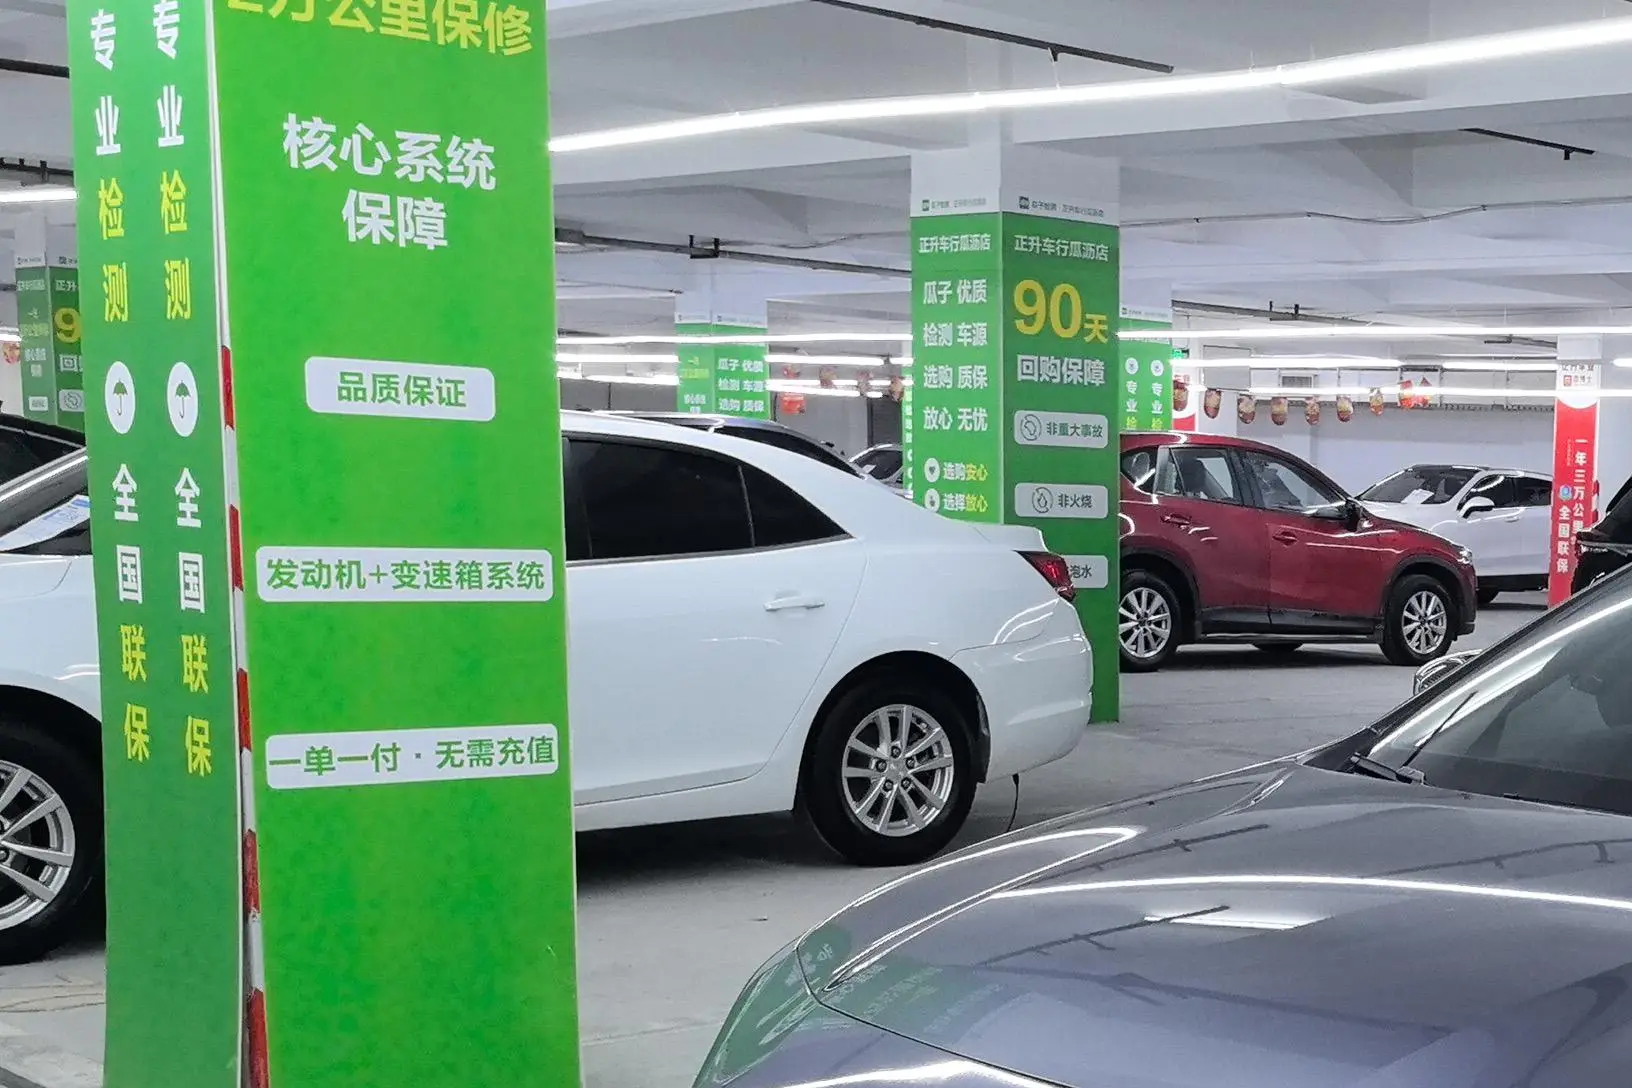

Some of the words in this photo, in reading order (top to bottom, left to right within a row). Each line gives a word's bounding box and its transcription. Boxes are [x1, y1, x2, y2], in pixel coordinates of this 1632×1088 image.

[228, 0, 533, 56] 公里保修
[90, 9, 128, 322] 专业检测
[153, 0, 191, 320] 专业检测
[283, 112, 497, 190] 核心系统
[342, 189, 449, 250] 保障
[919, 233, 991, 253] 正升车行瓜沥店
[1014, 234, 1109, 262] 正升车行瓜沥店
[923, 281, 951, 304] 瓜子
[956, 279, 987, 304] 优质
[1013, 279, 1109, 344] 90天
[923, 323, 952, 347] 检测
[957, 322, 988, 347] 车源
[923, 365, 952, 389] 选购
[957, 365, 988, 389] 质保
[1017, 354, 1105, 386] 回购保障
[337, 371, 467, 407] 品质保证
[923, 407, 952, 430] 放心
[957, 408, 988, 432] 无忧
[1046, 422, 1103, 438] 非重大事故
[943, 461, 988, 482] 选购安心
[943, 493, 988, 513] 选择放心
[1058, 493, 1092, 509] 非火烧
[1571, 438, 1588, 545] 一年三万公里
[266, 558, 545, 591] 发动机+变速箱系统
[1067, 564, 1092, 579] 泡水
[112, 464, 151, 763] 全国联保
[175, 467, 212, 777] 全国联保
